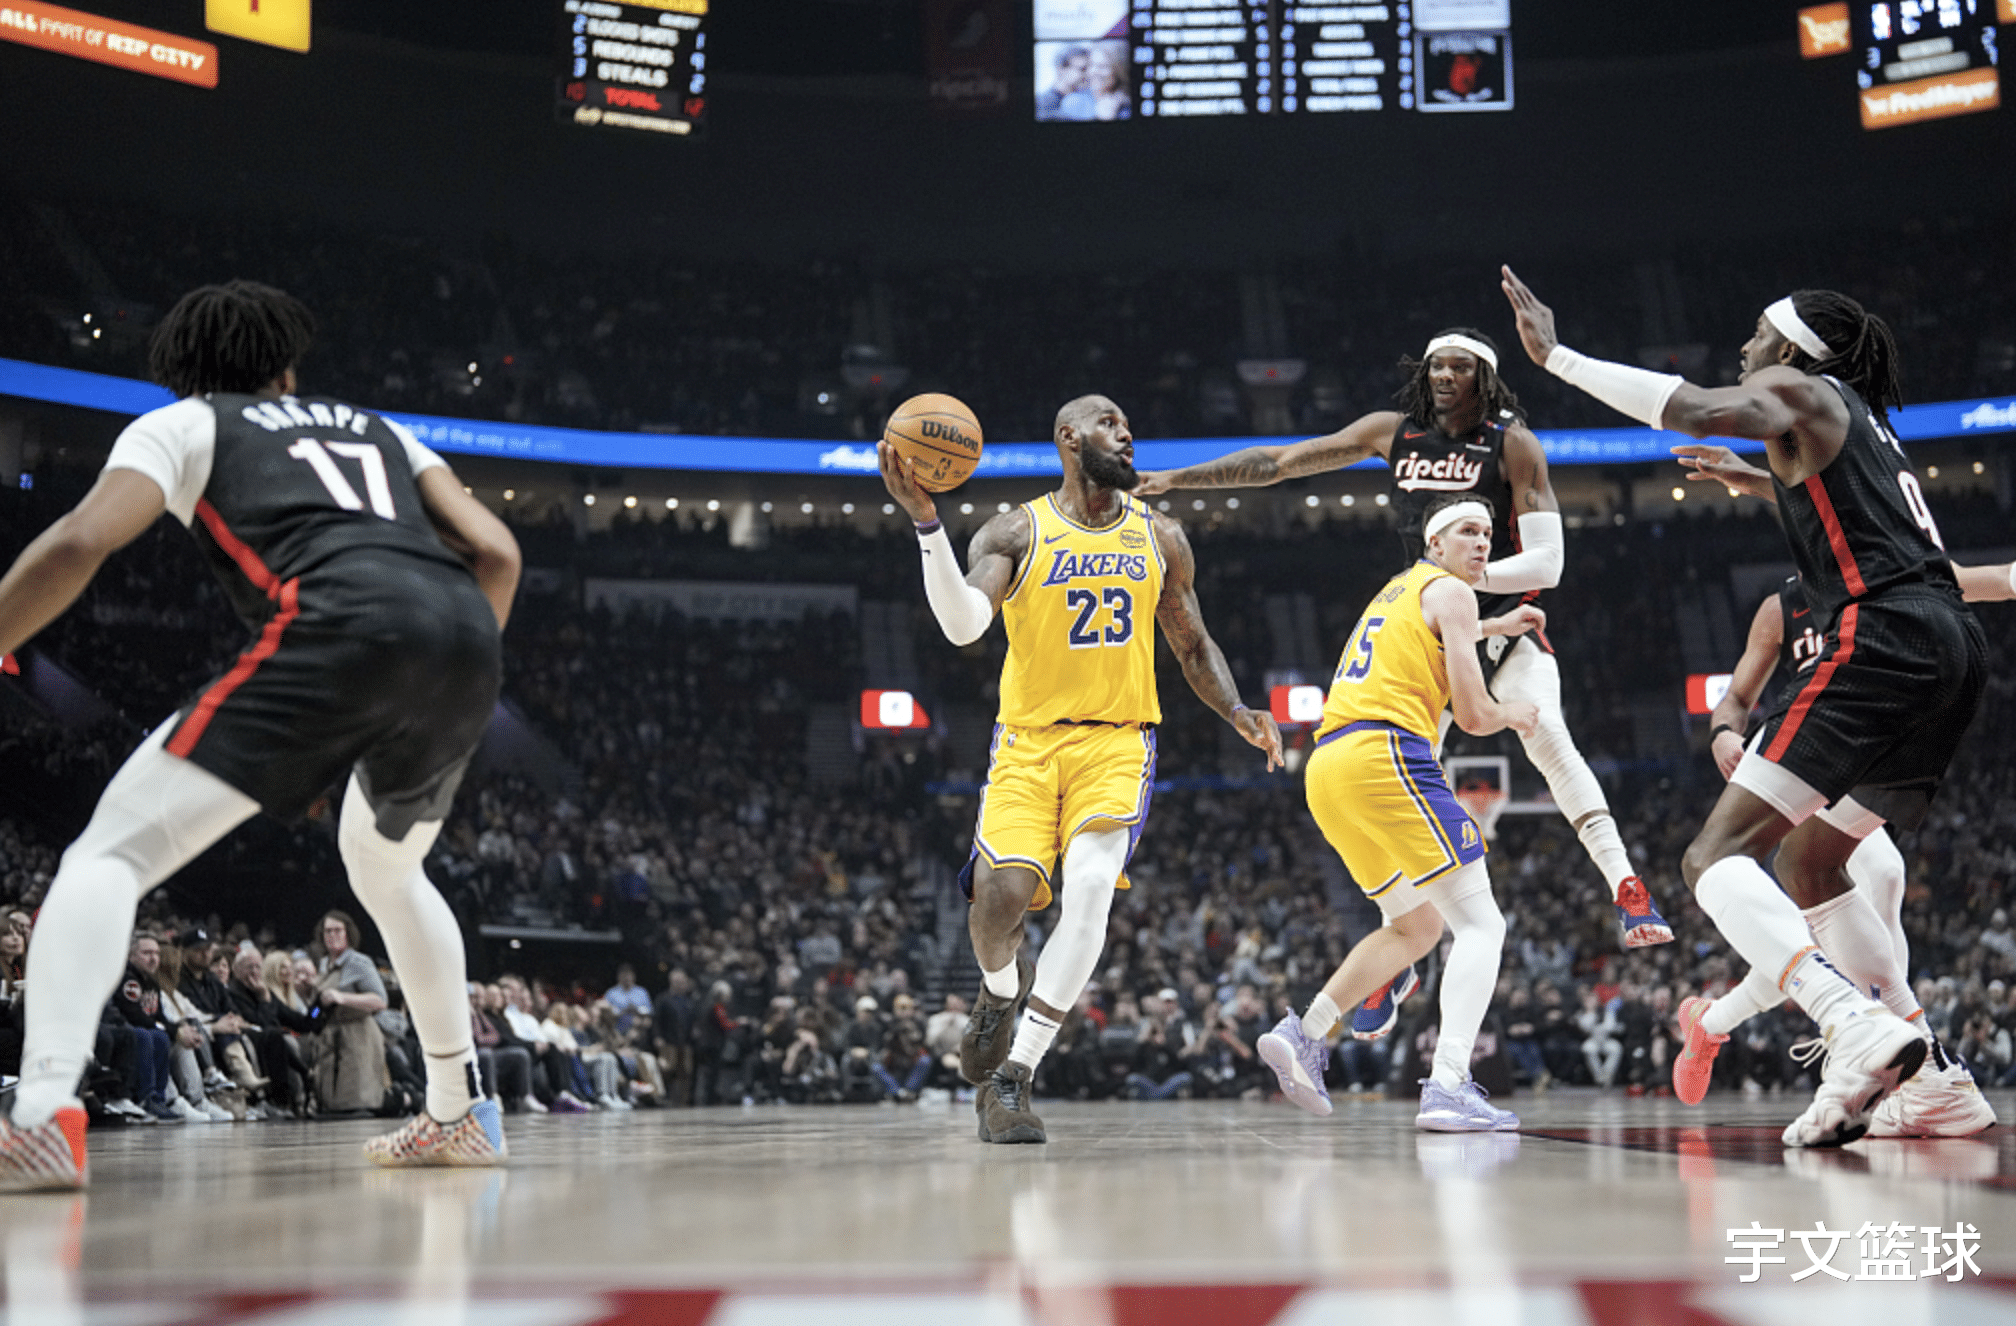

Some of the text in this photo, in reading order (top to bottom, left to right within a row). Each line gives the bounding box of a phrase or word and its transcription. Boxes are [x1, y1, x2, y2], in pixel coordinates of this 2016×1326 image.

[107, 33, 150, 57] RIP
[150, 43, 205, 71] CITY
[597, 61, 669, 88] STEALS
[921, 420, 979, 454] Wilson
[287, 437, 397, 521] 17
[1395, 451, 1484, 493] ripcity
[1041, 548, 1148, 588] LAKERS
[1066, 587, 1134, 650] 23
[1333, 617, 1385, 684] 15
